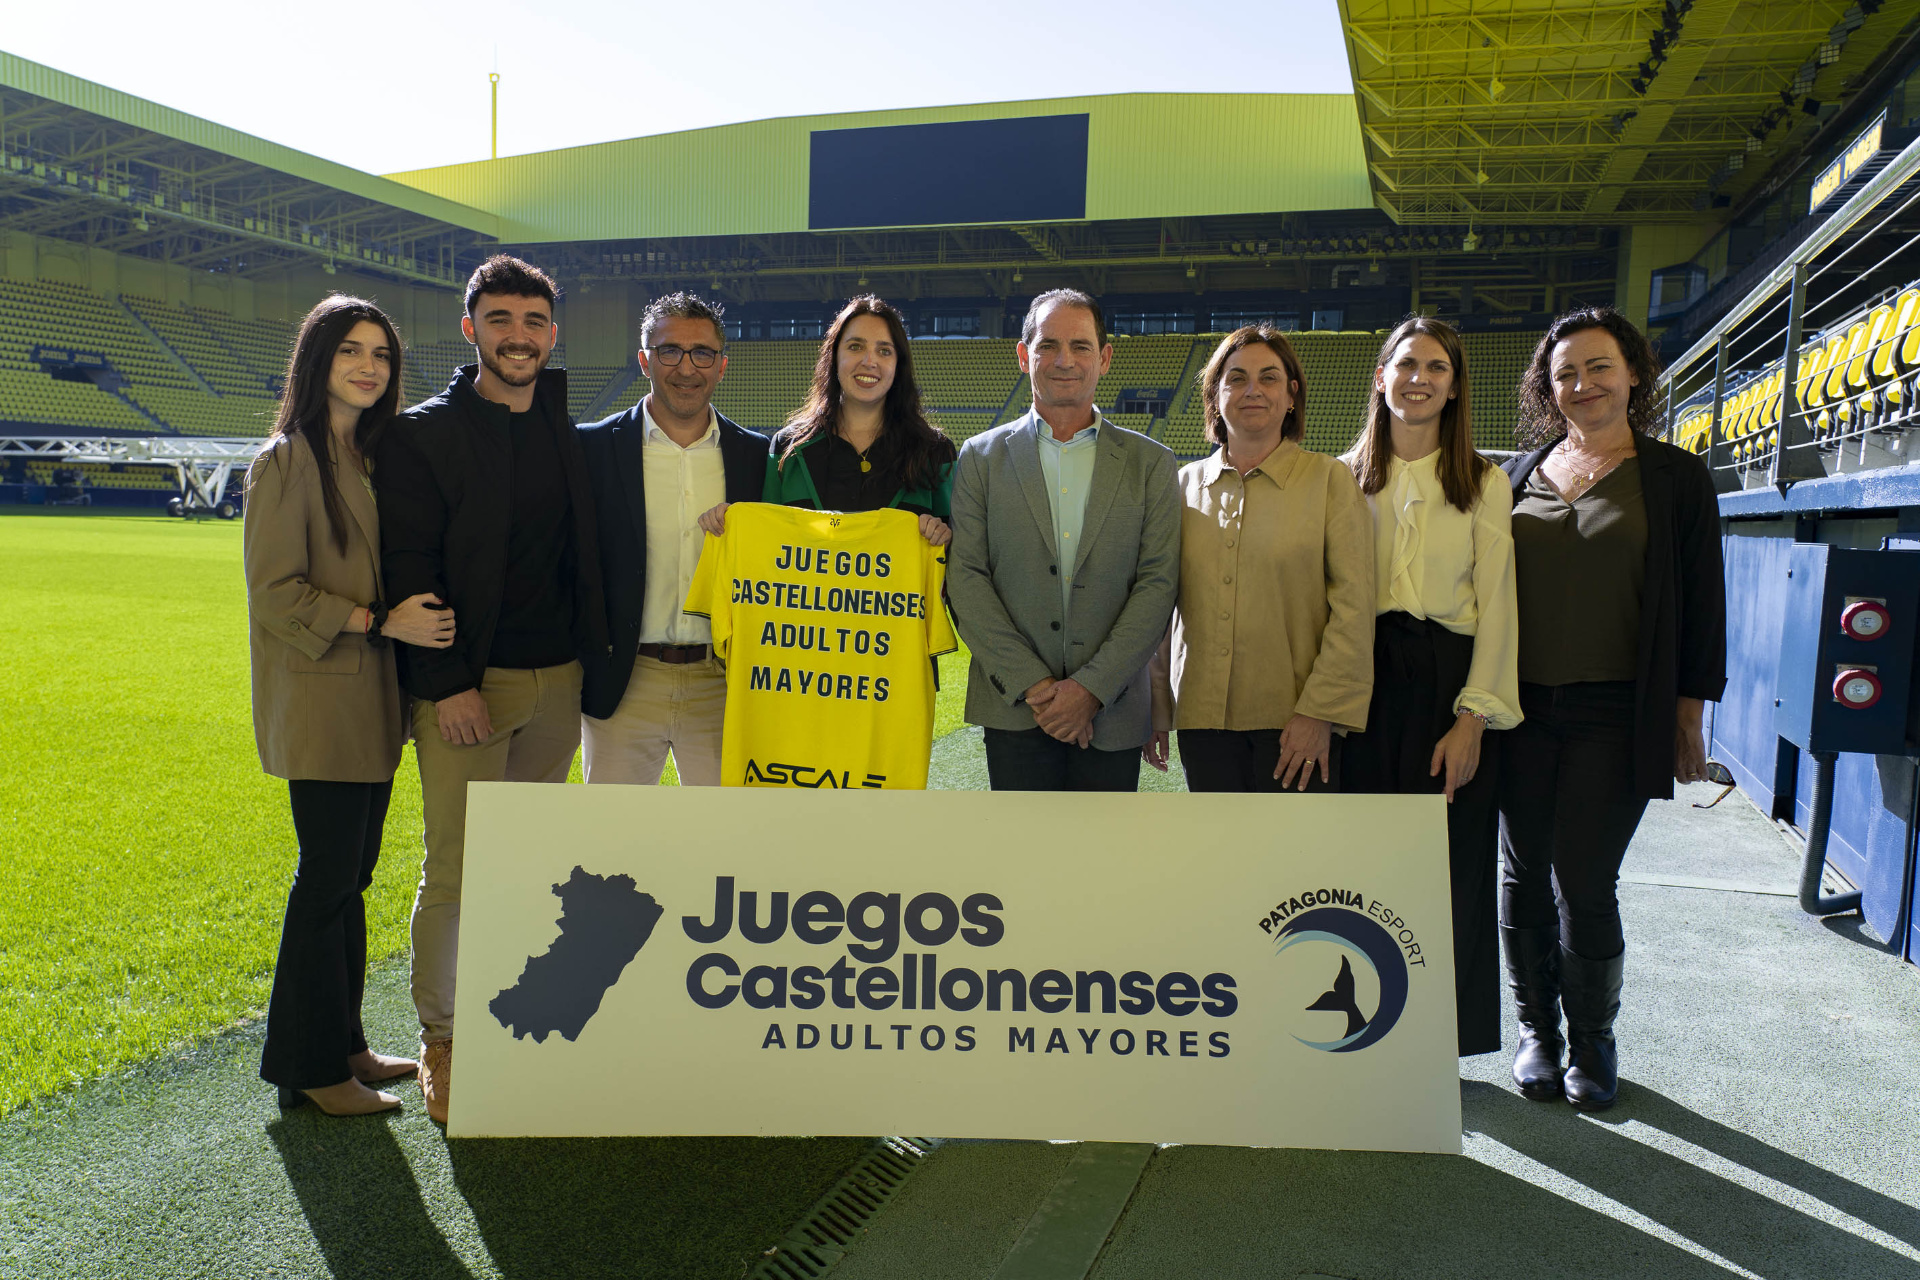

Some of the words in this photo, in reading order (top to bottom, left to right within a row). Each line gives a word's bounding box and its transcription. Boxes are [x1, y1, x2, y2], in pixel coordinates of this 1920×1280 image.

[775, 545, 892, 578] JUEGOS
[731, 578, 926, 620] CASTELLONENSES
[760, 621, 891, 656] ADULTOS
[750, 665, 890, 702] MAYORES
[744, 759, 887, 789] ASCALE
[681, 875, 1005, 964] Juegos
[1258, 888, 1364, 935] PATAGONIA
[1367, 899, 1426, 969] ESPORT
[686, 952, 1240, 1018] Castellonenses
[761, 1023, 977, 1052] ADULTOS
[1008, 1026, 1232, 1059] MAYORES
